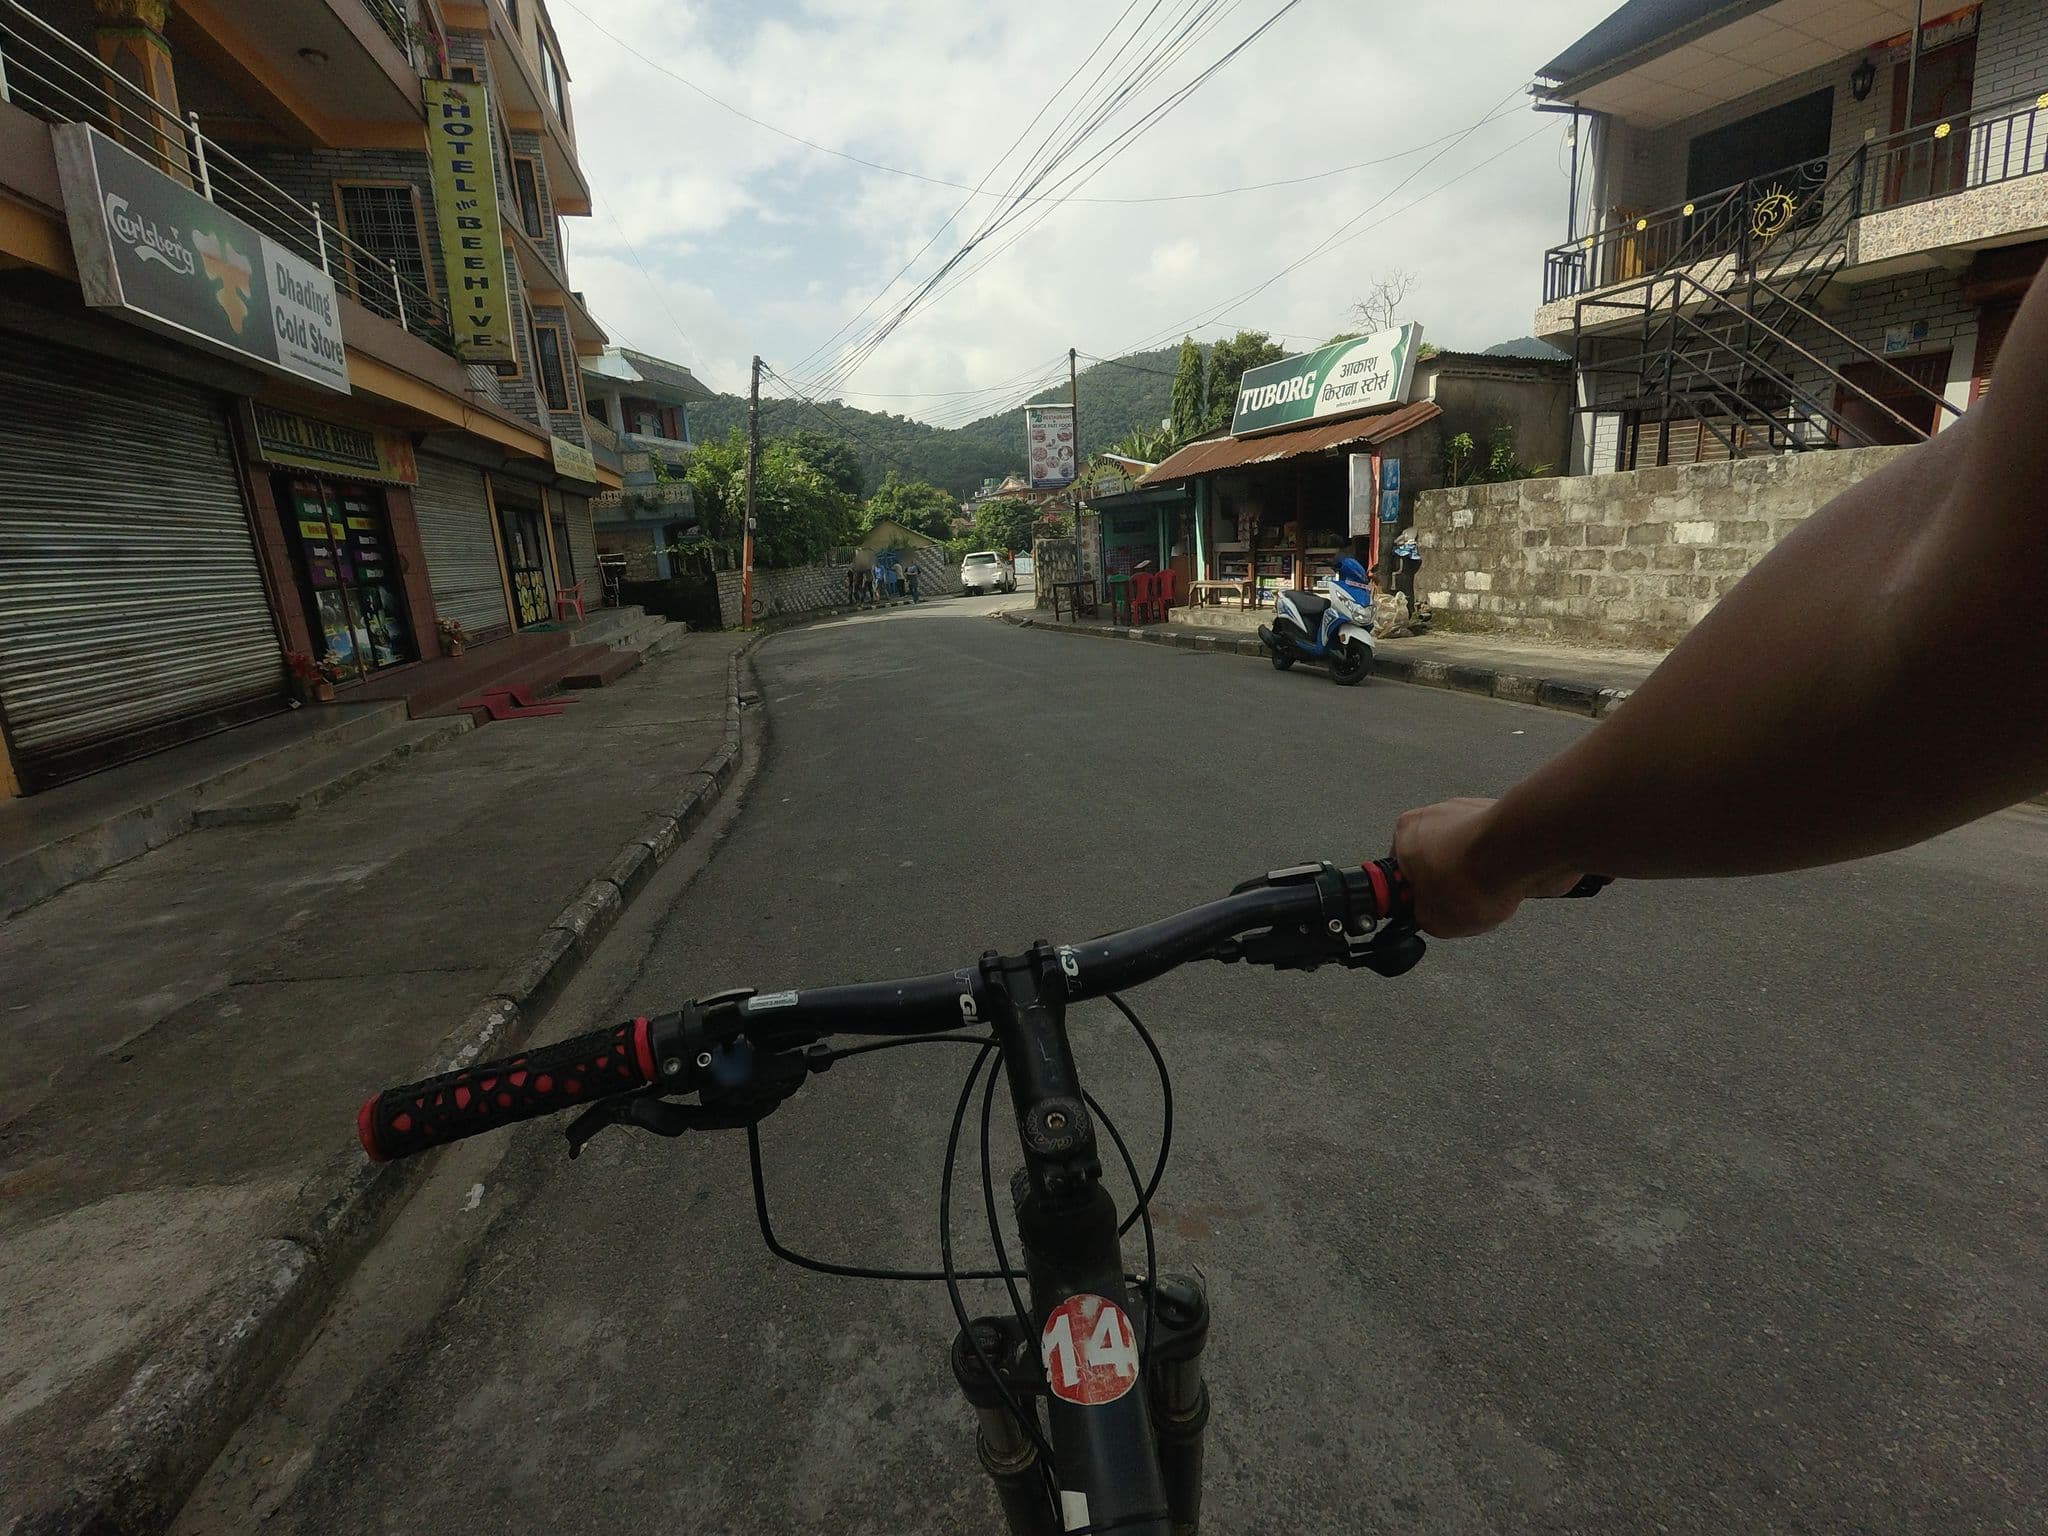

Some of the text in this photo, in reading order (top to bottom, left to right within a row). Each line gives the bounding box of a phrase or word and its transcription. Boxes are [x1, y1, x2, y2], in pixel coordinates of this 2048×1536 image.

[106, 192, 195, 275] Carlsberg
[442, 103, 492, 346] HOTEL the BEEHIVE
[276, 261, 332, 327] Dhading
[275, 305, 308, 350] Cold
[309, 322, 344, 365] Store
[1240, 370, 1318, 416] TUBORG
[1322, 381, 1359, 403] किराना
[1360, 370, 1390, 395] स्टोर्स
[1339, 356, 1379, 378] आकाश
[1042, 1306, 1136, 1388] 14
